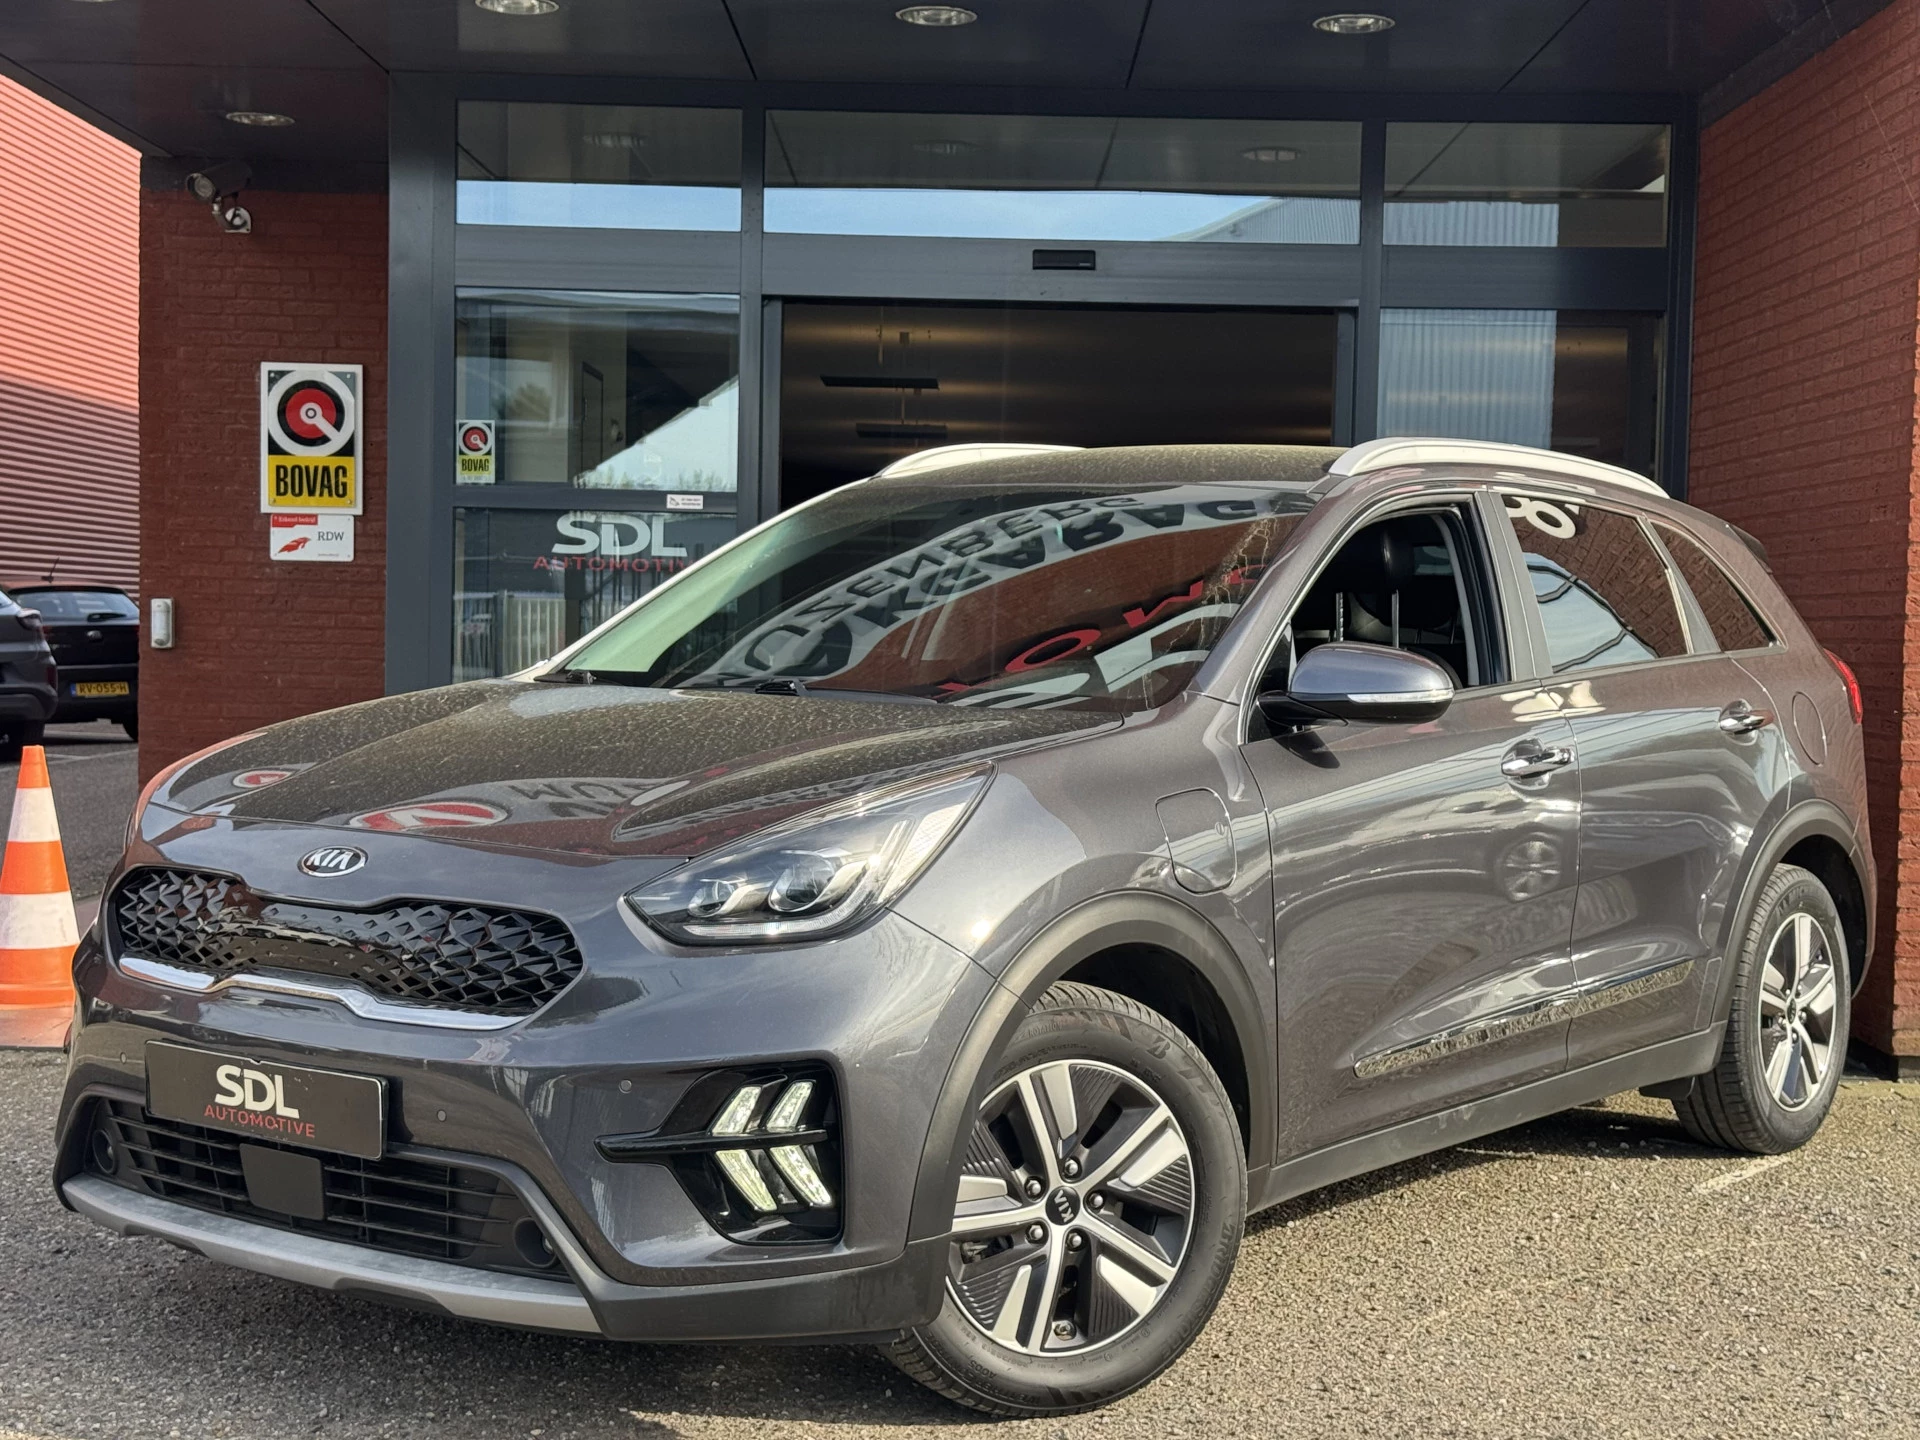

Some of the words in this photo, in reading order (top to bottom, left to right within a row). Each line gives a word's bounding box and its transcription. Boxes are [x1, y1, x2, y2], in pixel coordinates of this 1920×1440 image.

[275, 464, 348, 498] BOVAG
[461, 458, 490, 472] BOVAG
[317, 531, 344, 541] RDW
[551, 513, 688, 557] SDL
[306, 849, 354, 870] KIA
[214, 1064, 300, 1119] SDL
[204, 1104, 315, 1139] AUTOMOTIVE
[1053, 1189, 1075, 1223] KIA
